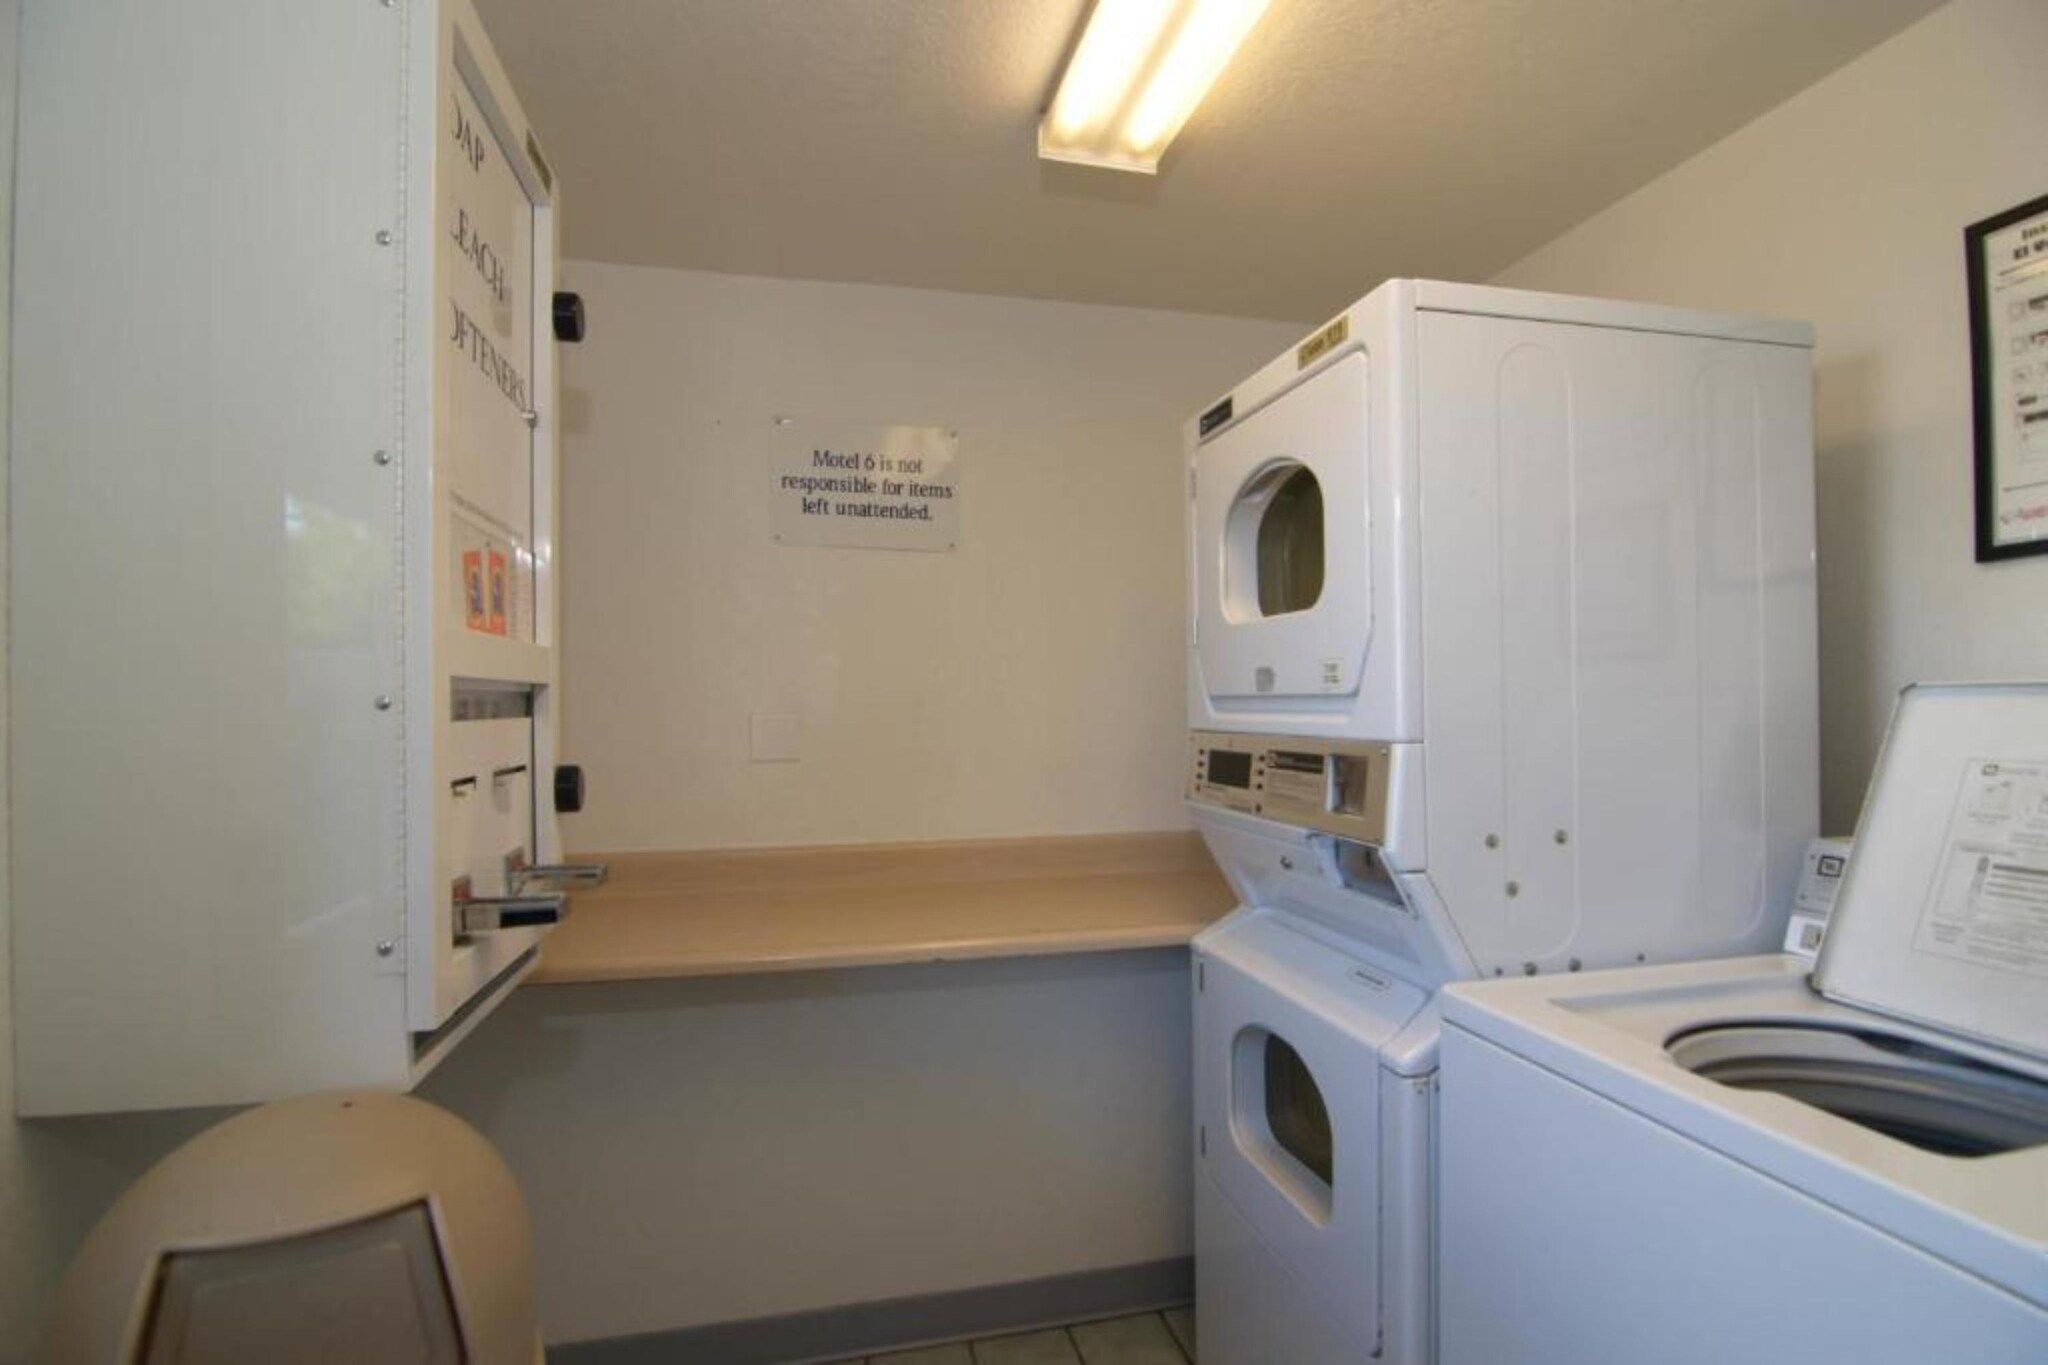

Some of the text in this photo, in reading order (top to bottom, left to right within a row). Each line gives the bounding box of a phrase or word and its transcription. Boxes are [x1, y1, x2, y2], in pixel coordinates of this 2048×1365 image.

[813, 450, 923, 474] Motel 6 is not
[782, 475, 953, 499] responsible for items
[802, 497, 933, 521] left unattended.
